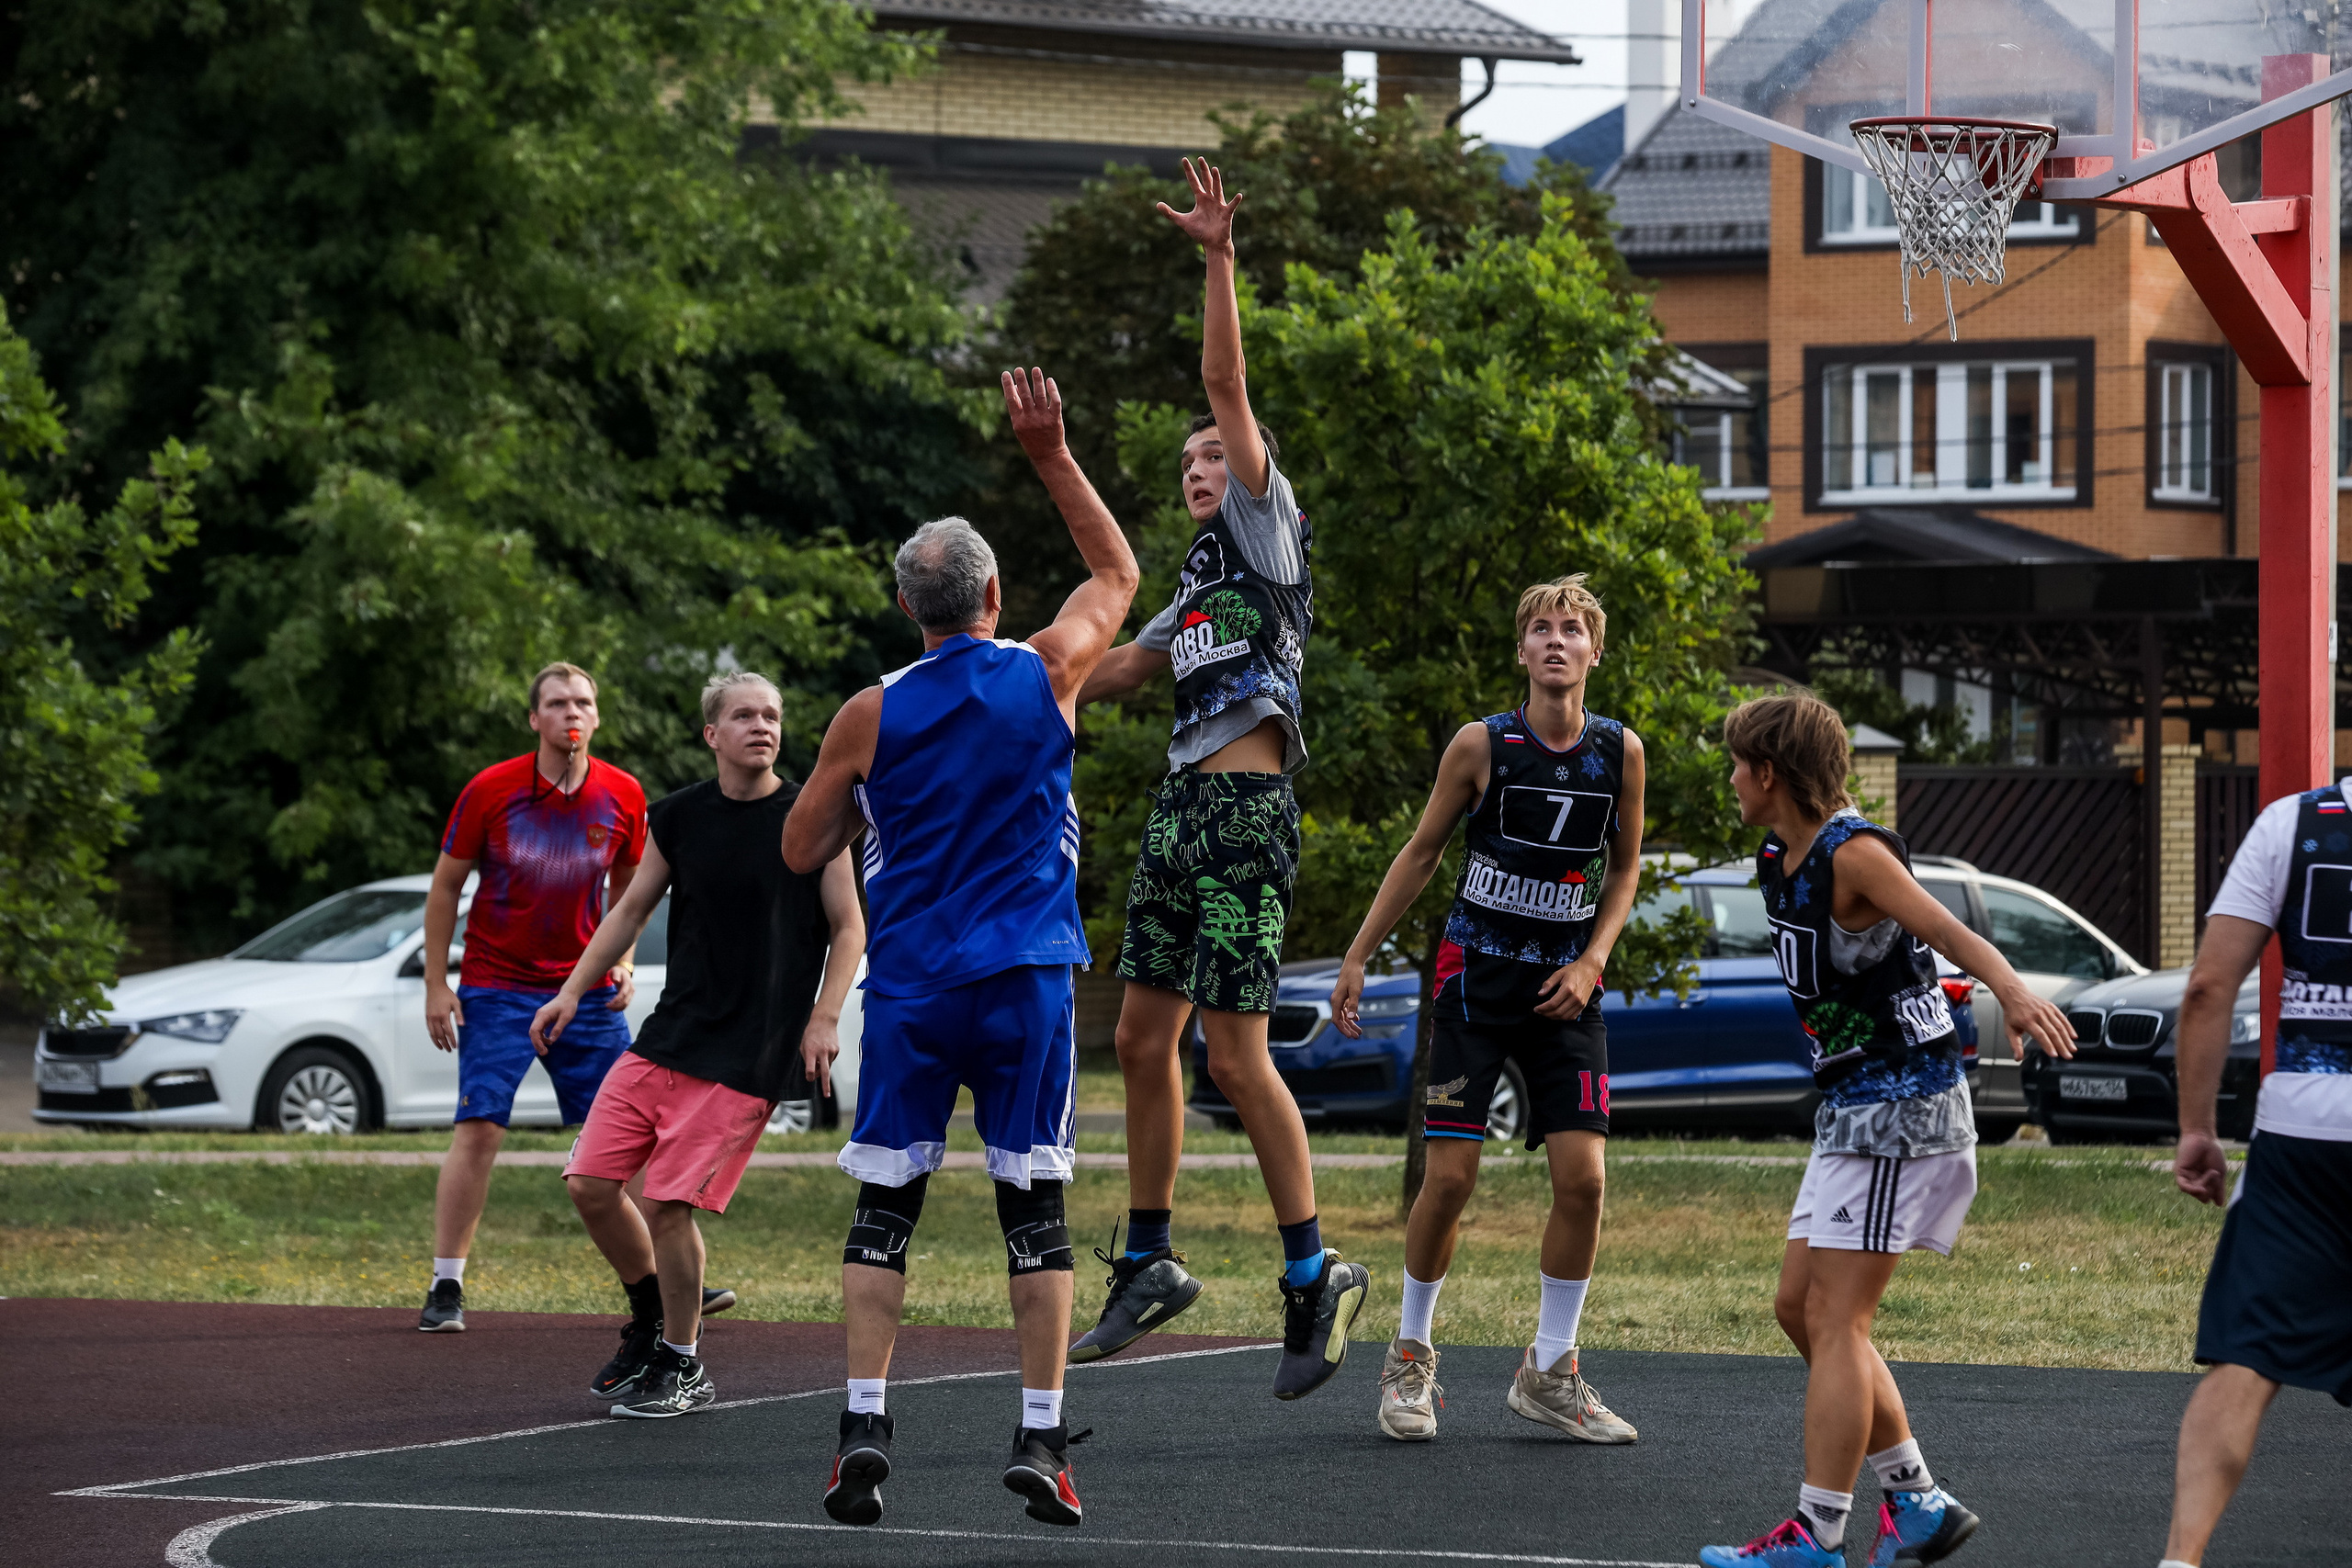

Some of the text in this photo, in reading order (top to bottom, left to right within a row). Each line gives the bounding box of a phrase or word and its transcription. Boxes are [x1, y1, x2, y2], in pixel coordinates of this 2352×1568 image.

[1198, 643, 1249, 663] Москва
[1546, 795, 1574, 841] 7
[1465, 860, 1585, 910] ПОТАПОВО
[1465, 888, 1488, 904] Моя
[1491, 900, 1565, 919] маленькая
[869, 1250, 888, 1262] NBA
[1024, 1256, 1042, 1268] NBA
